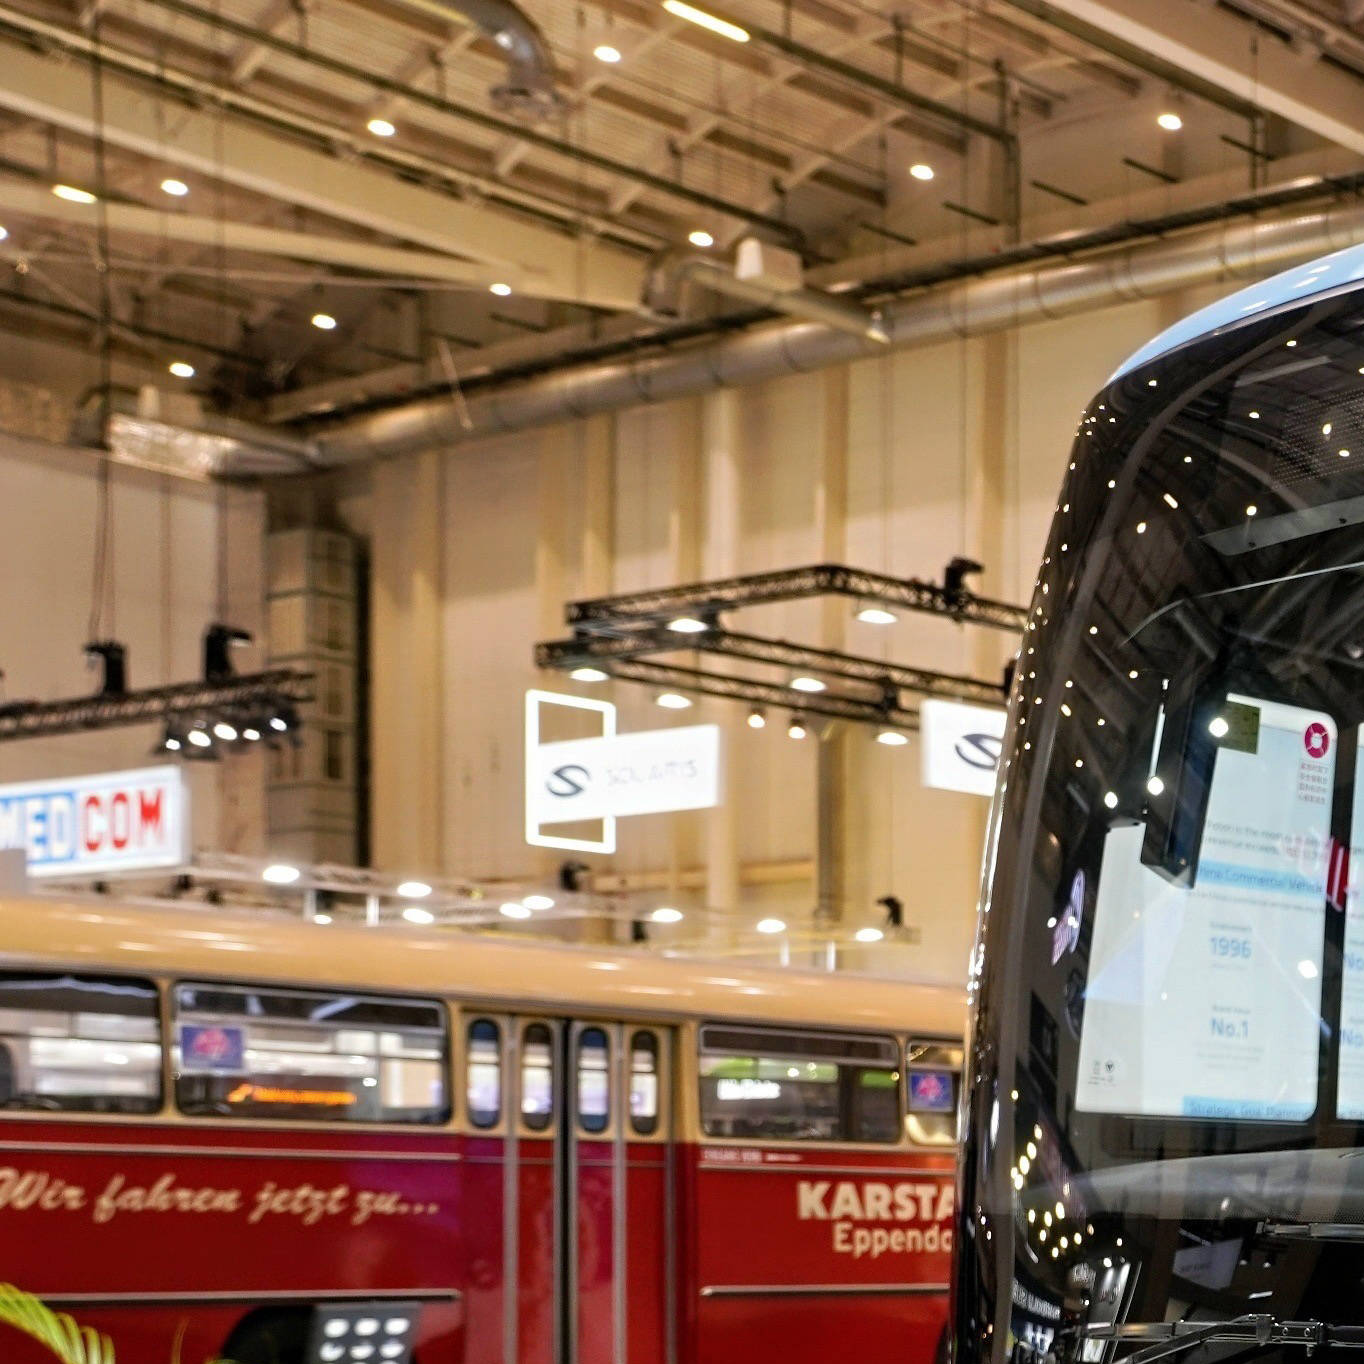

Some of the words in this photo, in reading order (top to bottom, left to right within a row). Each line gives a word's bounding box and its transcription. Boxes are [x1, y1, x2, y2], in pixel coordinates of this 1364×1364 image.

[1209, 935, 1253, 960] 1996
[1209, 1017, 1250, 1038] No.1
[0, 1167, 88, 1211] Wir
[92, 1173, 241, 1224] fahren
[247, 1181, 350, 1225] jetzt
[350, 1190, 439, 1226] zu...
